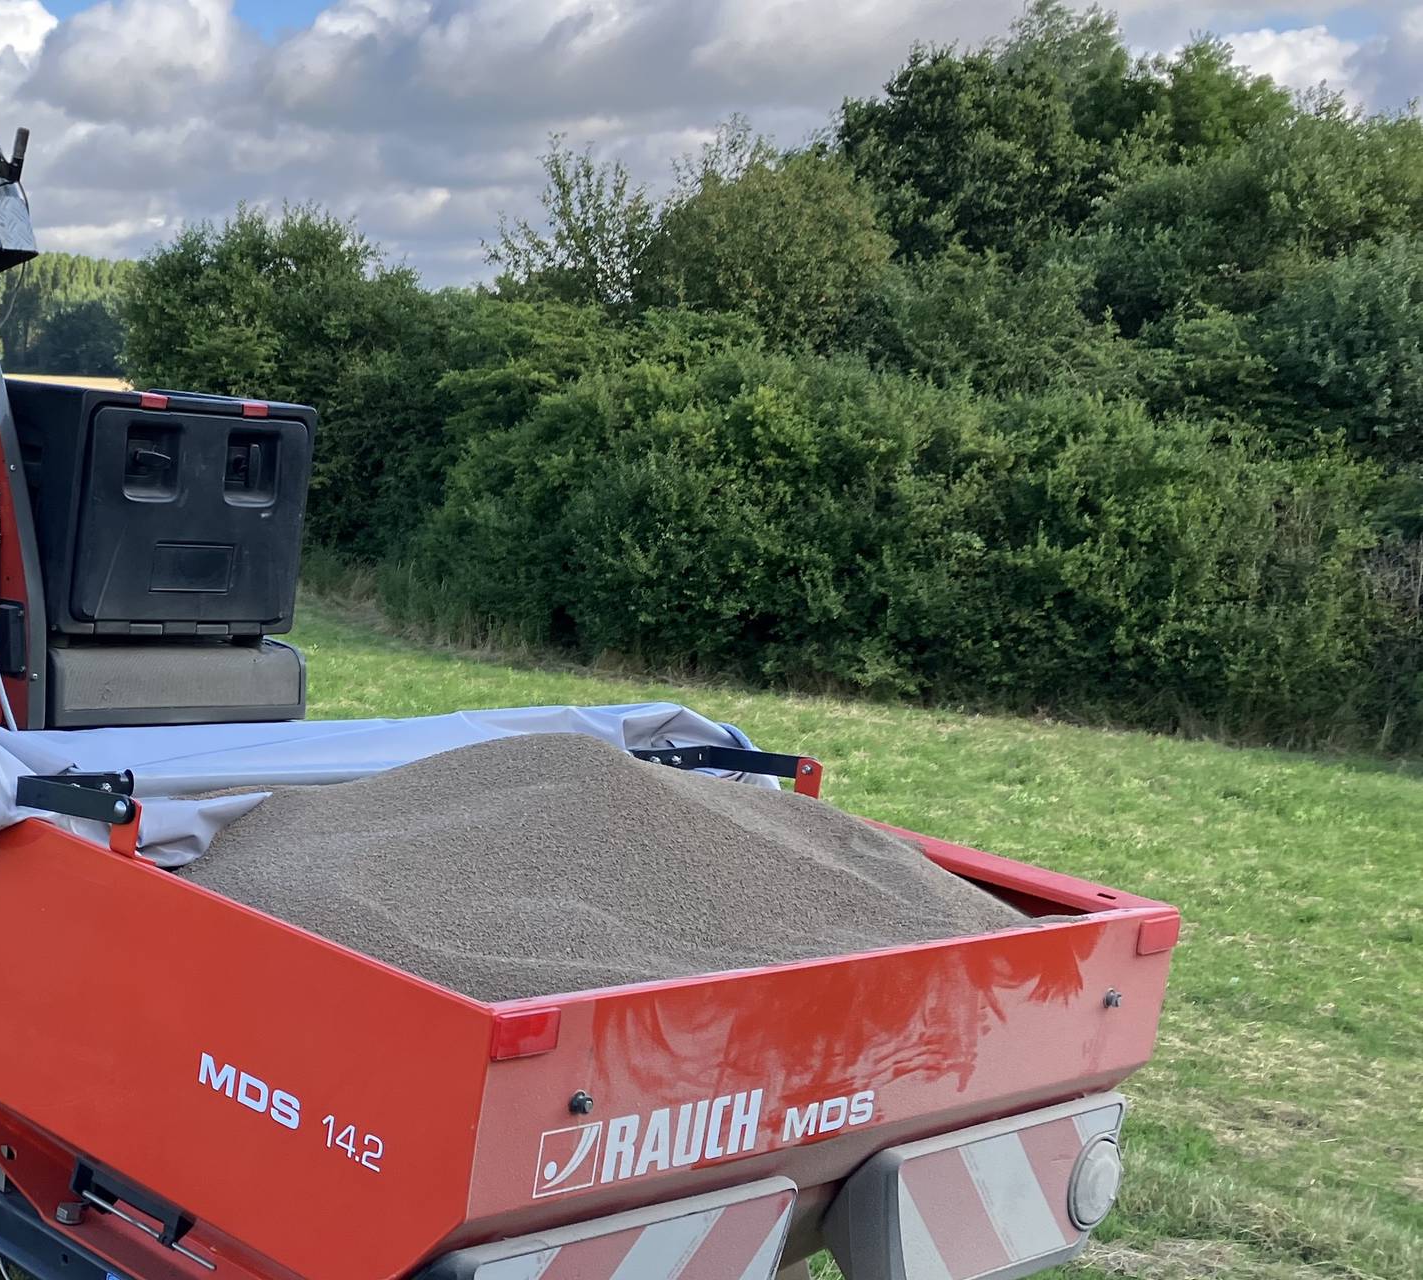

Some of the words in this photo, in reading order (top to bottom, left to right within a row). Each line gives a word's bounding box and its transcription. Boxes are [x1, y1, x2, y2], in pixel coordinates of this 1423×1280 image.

[198, 1052, 301, 1130] MDS
[322, 1114, 384, 1173] 14.2
[600, 1088, 764, 1184] RAUCH
[782, 1089, 875, 1143] MDS
